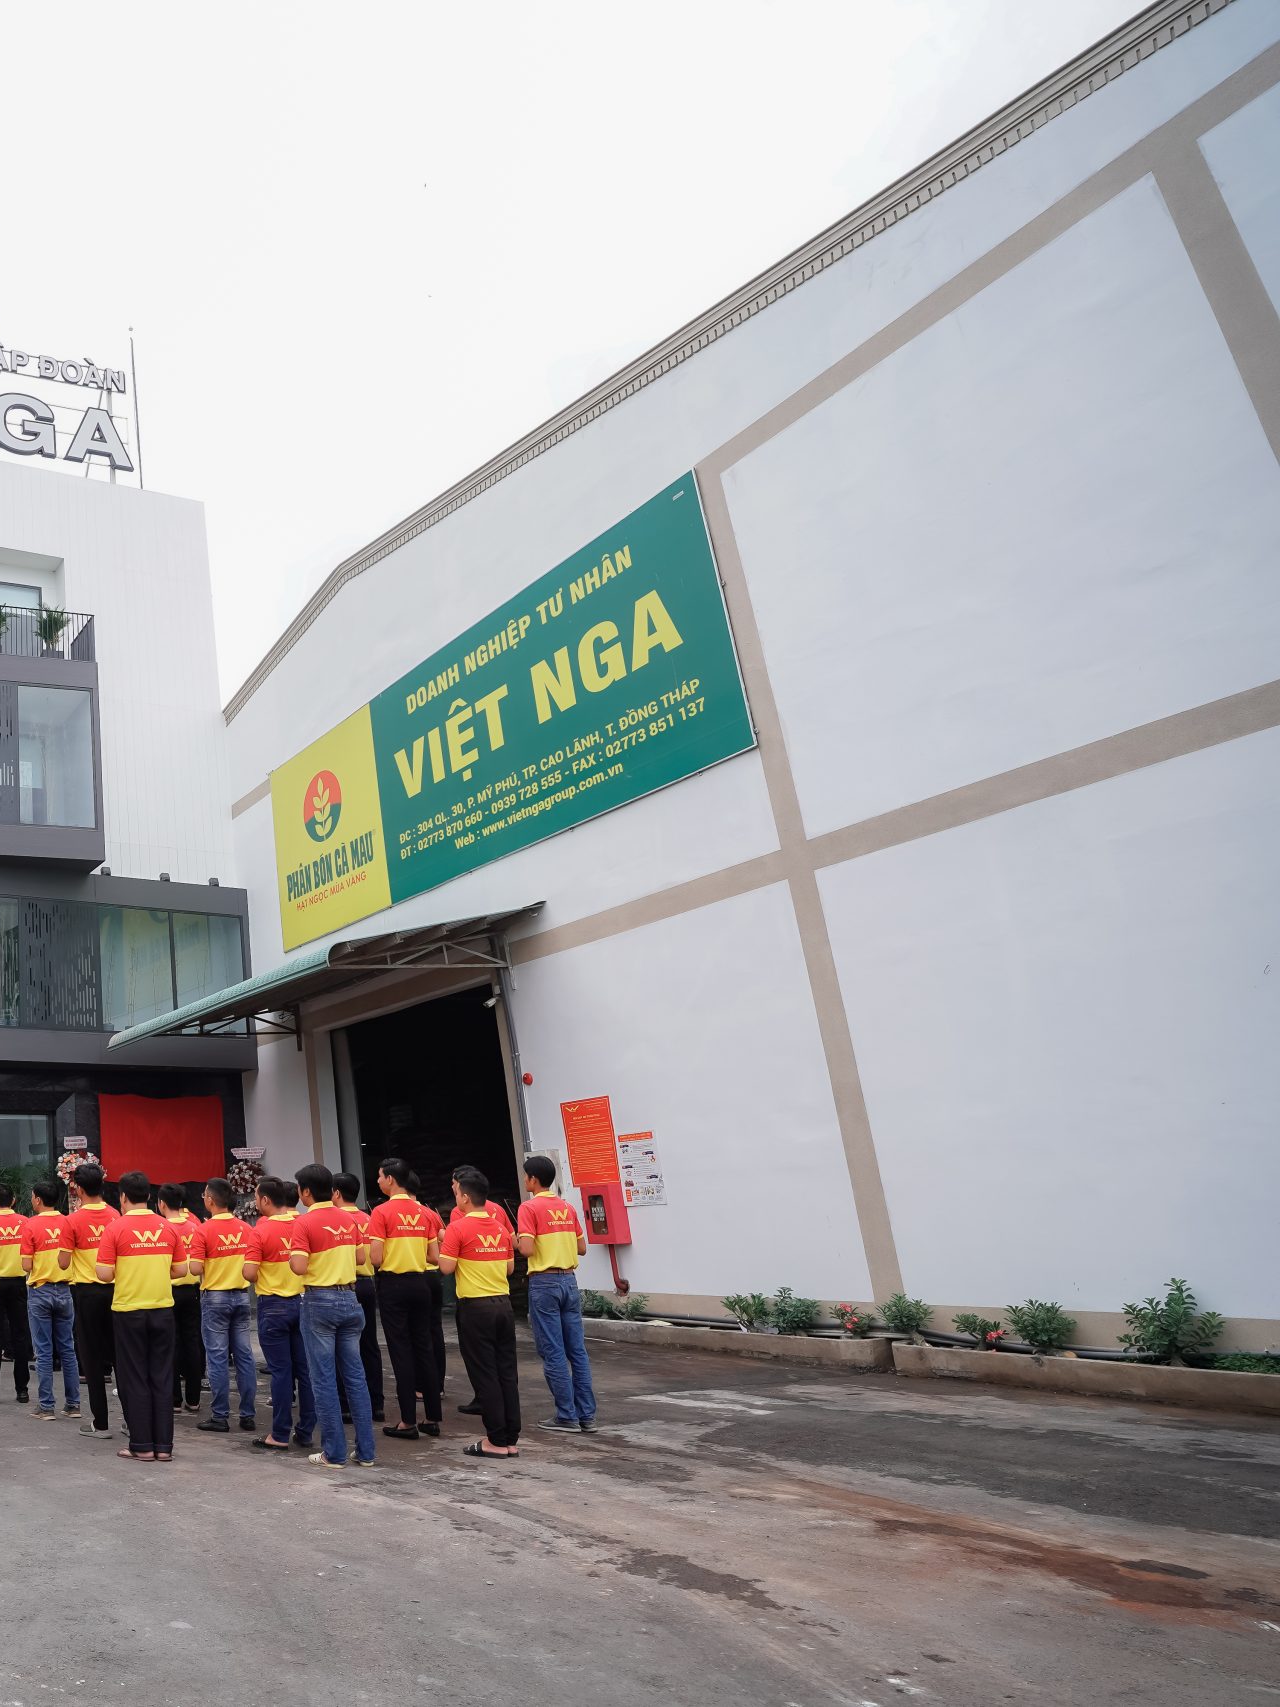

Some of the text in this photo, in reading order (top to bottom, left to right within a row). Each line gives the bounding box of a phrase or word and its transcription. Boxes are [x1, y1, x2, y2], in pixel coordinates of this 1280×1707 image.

[37, 355, 126, 394] ĐOÀN
[406, 544, 632, 715] DOANH NGHIỆP TƯ NHÂN
[393, 589, 684, 799] VIỆT NGA
[400, 846, 412, 860] ĐT
[417, 829, 445, 851] 02773
[446, 820, 463, 837] 870
[464, 810, 483, 828] 660
[491, 793, 517, 814] 0939
[517, 782, 539, 801] 728
[541, 770, 562, 790] 555
[572, 751, 596, 775] FAX
[605, 728, 647, 758] 02773
[648, 713, 674, 737] 851
[678, 696, 705, 721] 137
[417, 818, 433, 834] 304
[434, 808, 450, 825] QL.
[451, 802, 466, 816] 30,
[467, 797, 476, 808] P.
[477, 784, 493, 804] MỸ
[494, 771, 521, 795] PHÚ,
[522, 764, 538, 780] TP.
[540, 750, 564, 771] CAO
[566, 731, 604, 758] LÃNH,
[605, 722, 617, 738] T.
[619, 701, 659, 731] ĐỒNG
[660, 678, 700, 709] THÁP
[454, 832, 476, 849] Web
[482, 762, 624, 837] www.vietngagroup.com.vn
[286, 831, 374, 902] PHÂN BÓN CÀ MAU
[308, 889, 328, 904] NGỌC
